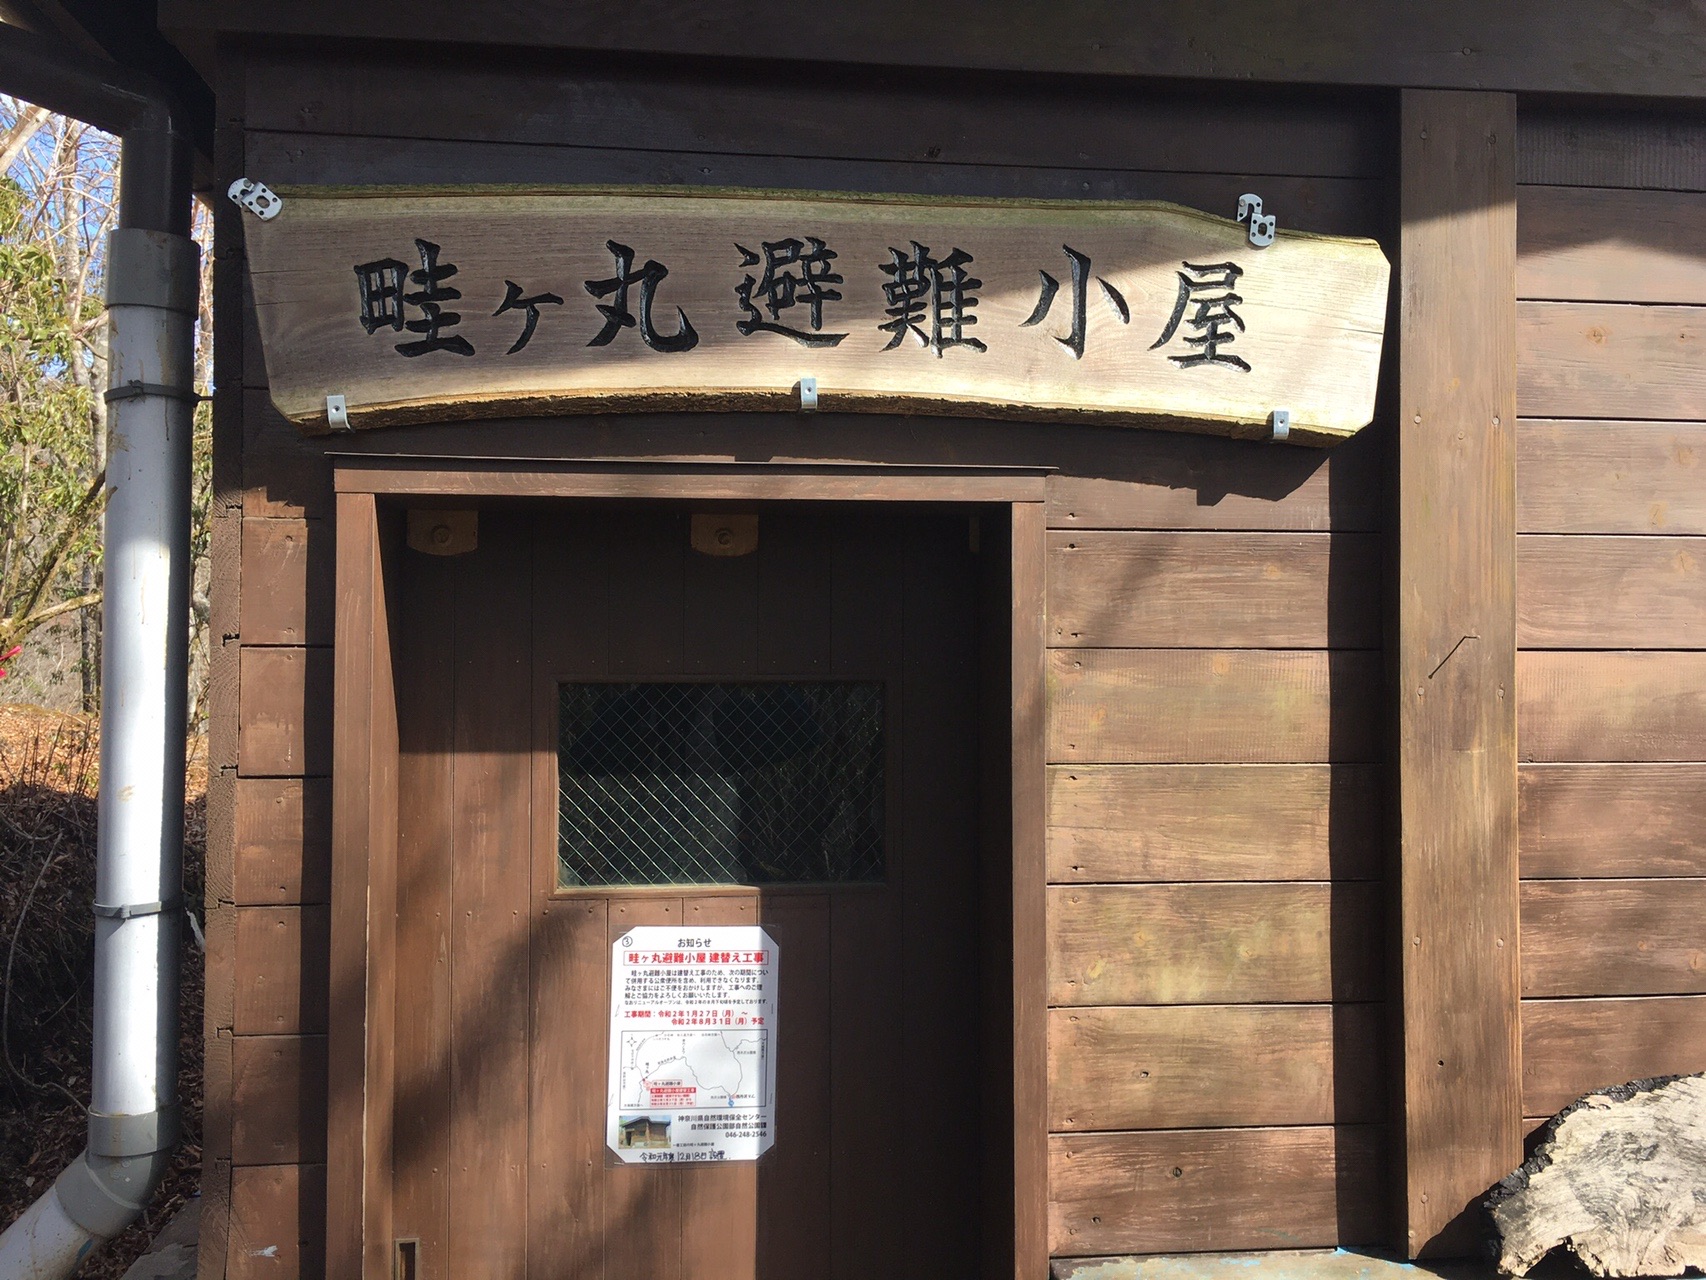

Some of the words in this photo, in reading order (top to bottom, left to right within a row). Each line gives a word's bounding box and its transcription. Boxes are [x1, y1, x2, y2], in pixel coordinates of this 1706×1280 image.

[354, 237, 1253, 373] 畦ヶ丸避難小屋
[677, 938, 712, 948] お知らせ
[678, 1114, 767, 1123] 神奈川県自然環境保全センター
